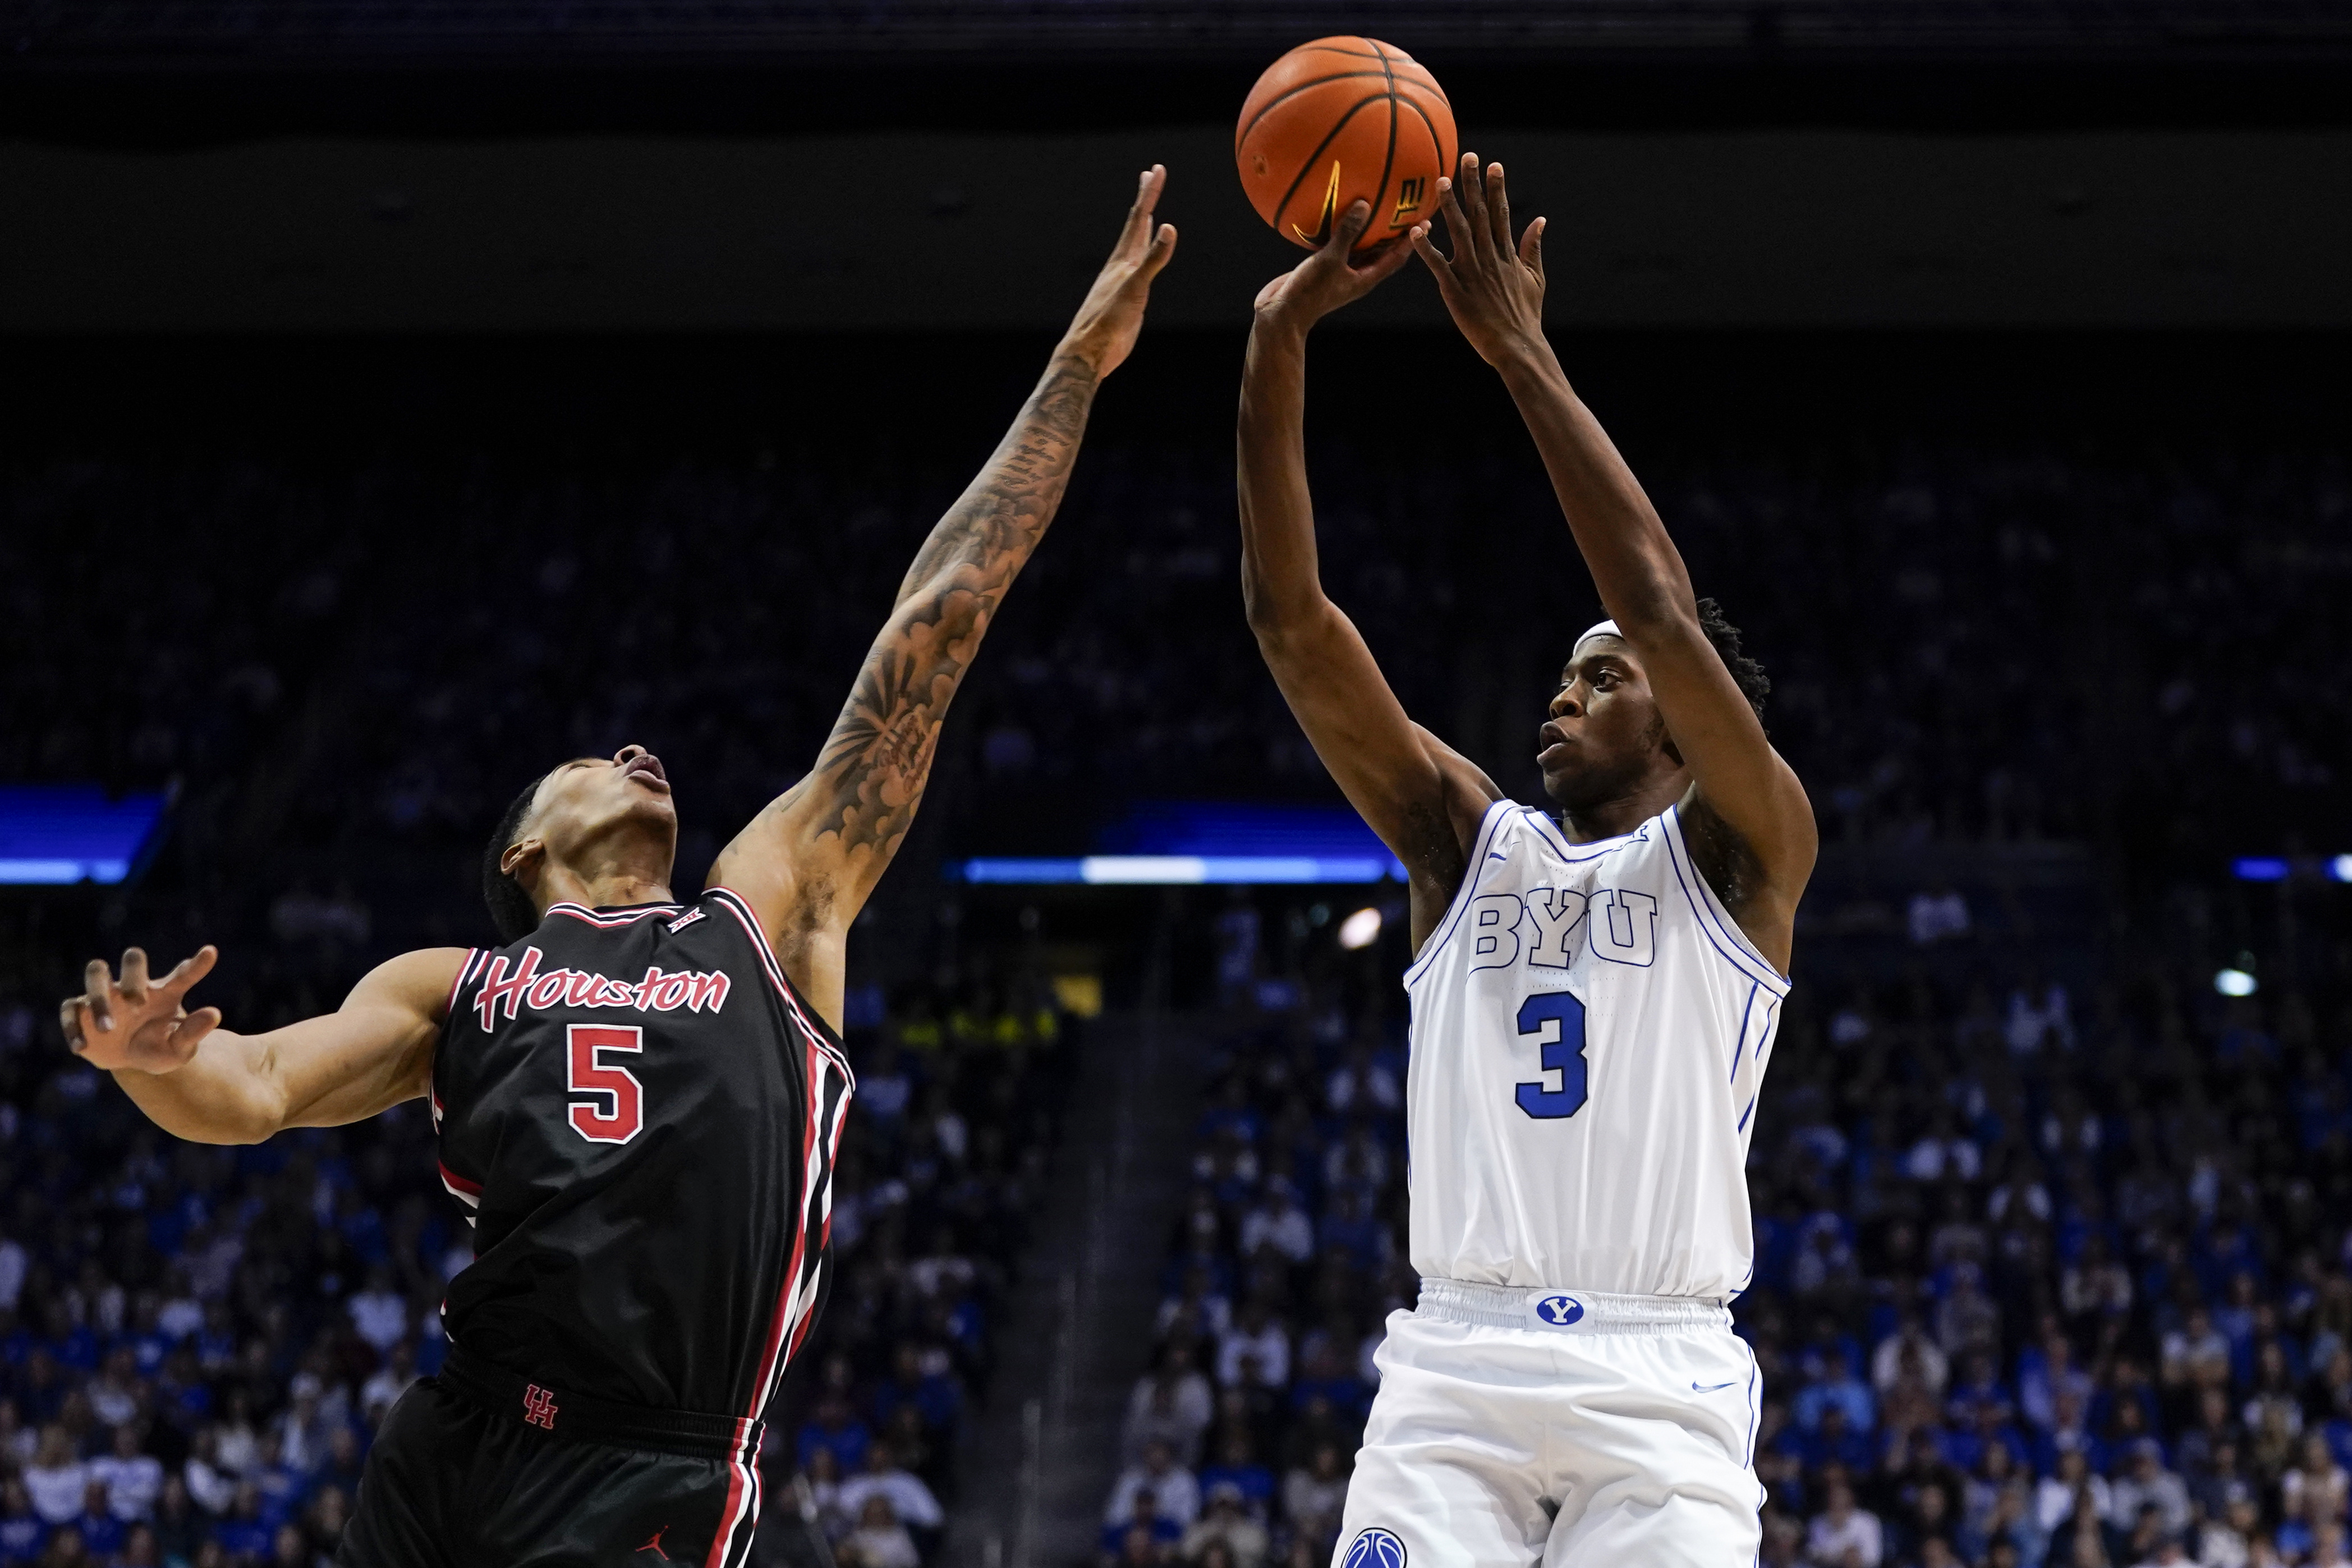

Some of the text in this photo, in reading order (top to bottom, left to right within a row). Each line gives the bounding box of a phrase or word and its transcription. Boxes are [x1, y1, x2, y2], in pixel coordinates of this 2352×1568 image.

[1468, 888, 1658, 972] BYU
[472, 946, 731, 1033] Houston
[566, 1023, 644, 1145] 5
[1515, 991, 1588, 1119] 3
[1545, 1298, 1578, 1323] Y
